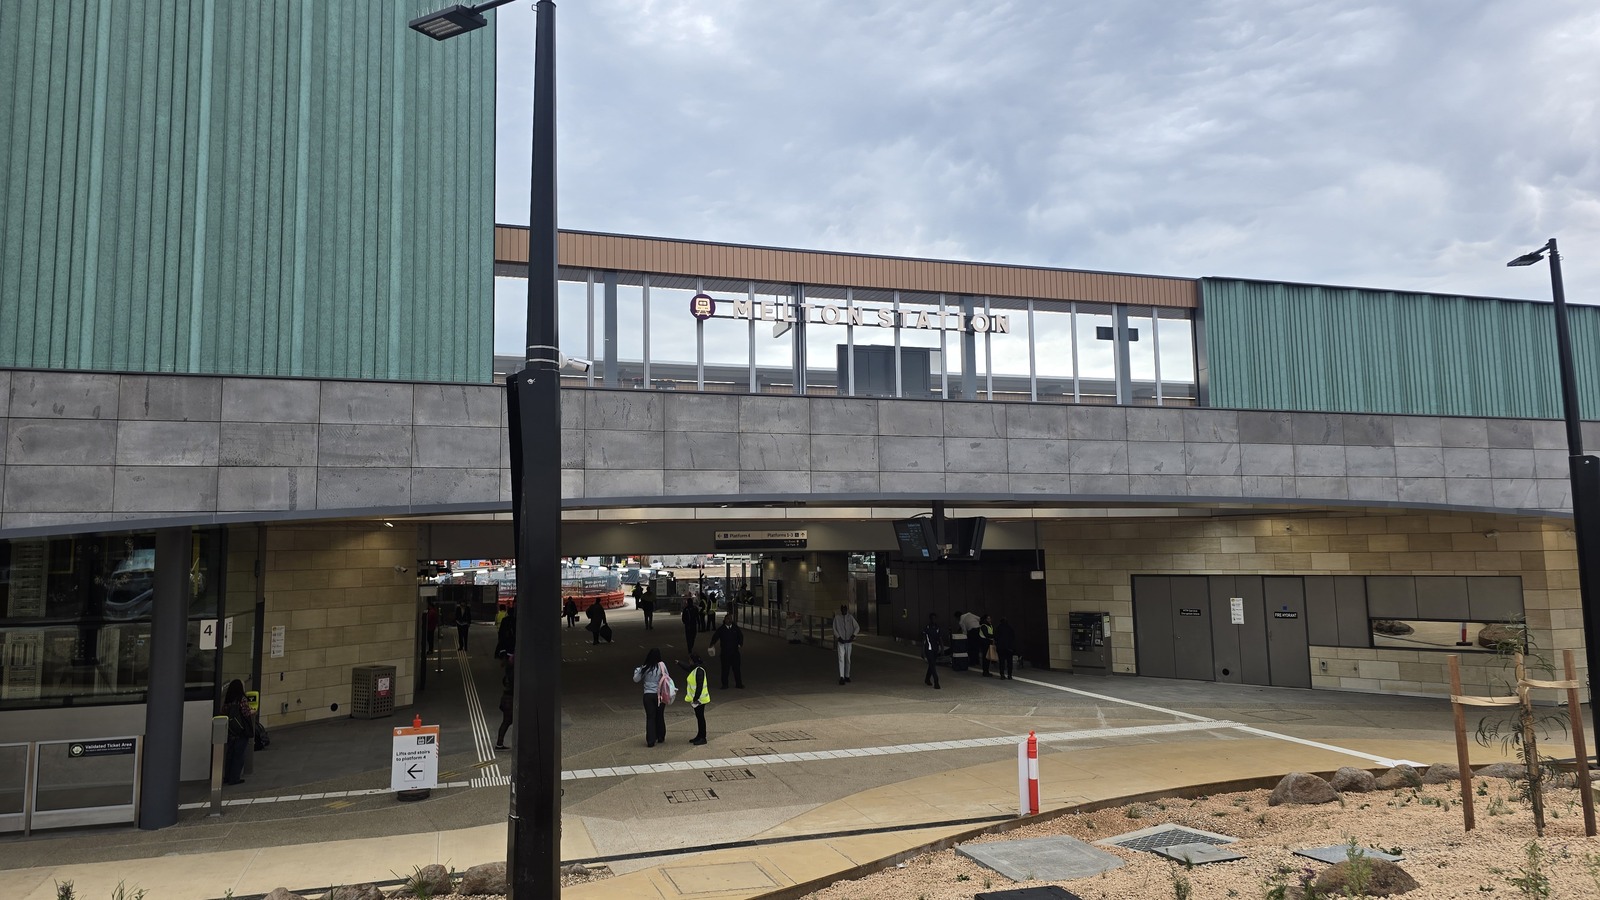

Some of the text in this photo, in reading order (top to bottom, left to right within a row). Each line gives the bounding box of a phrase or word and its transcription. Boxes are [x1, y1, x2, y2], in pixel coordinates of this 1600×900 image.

[733, 299, 1010, 333] MELTON STATION
[203, 624, 213, 637] 4
